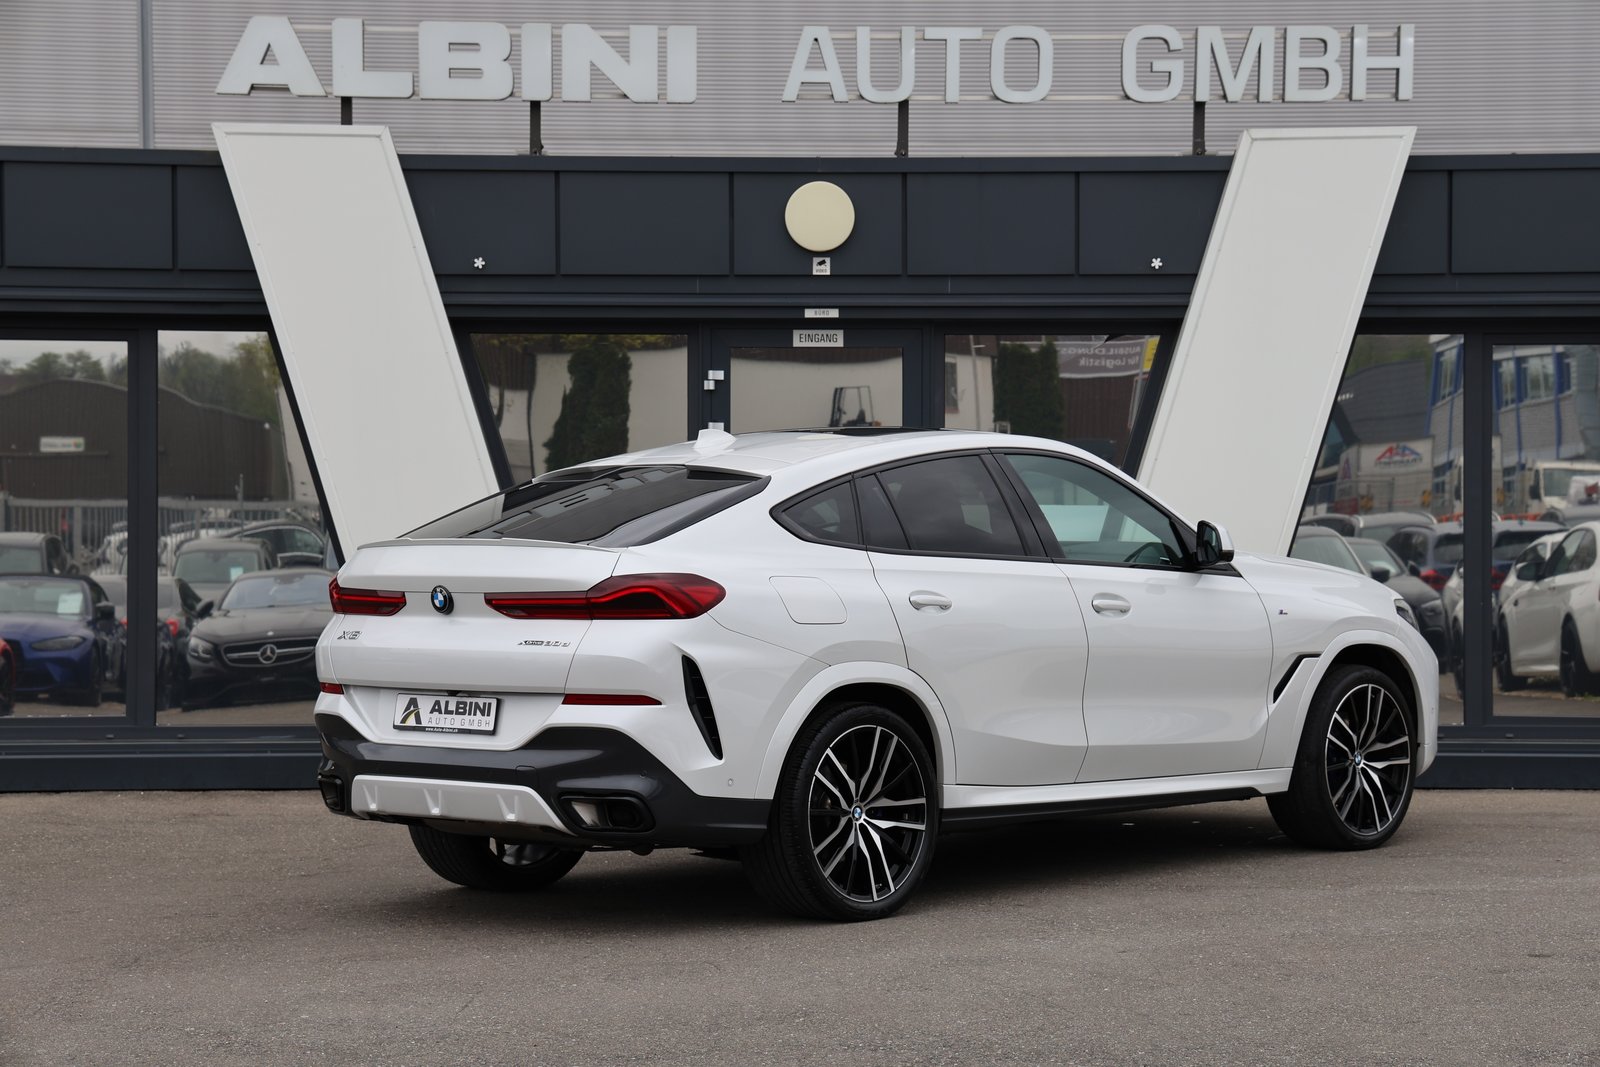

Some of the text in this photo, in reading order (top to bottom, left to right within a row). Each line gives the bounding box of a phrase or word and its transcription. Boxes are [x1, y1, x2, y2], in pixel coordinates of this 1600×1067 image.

[216, 16, 1416, 104] ALBINI AUTO GMBH
[799, 333, 838, 343] EINGANG
[337, 630, 362, 640] X6
[429, 699, 492, 717] ALBINI
[428, 717, 490, 727] AUTO GMBH
